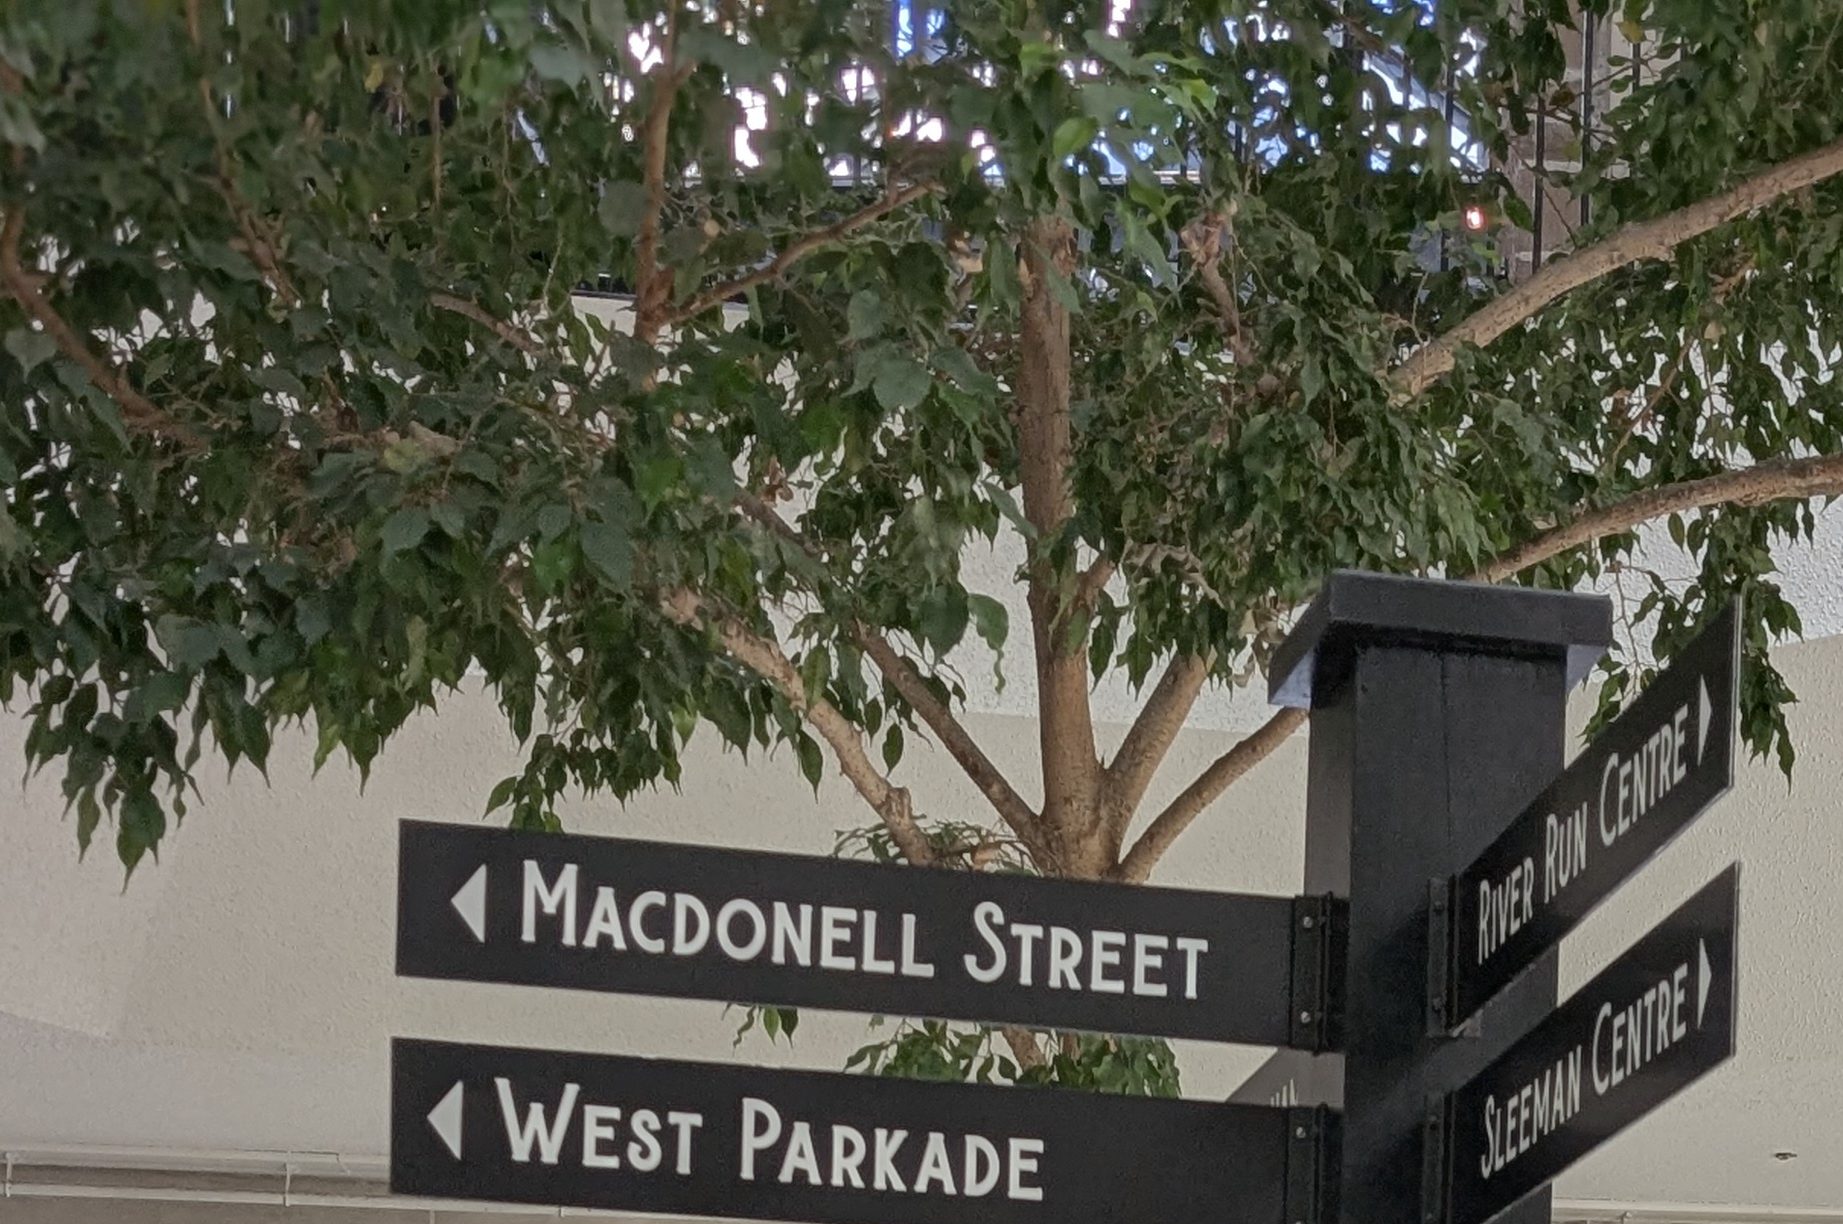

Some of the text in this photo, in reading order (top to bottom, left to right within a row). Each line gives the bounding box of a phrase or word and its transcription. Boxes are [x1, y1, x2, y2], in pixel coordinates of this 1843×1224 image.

[1478, 704, 1688, 964] RIVER RUN CENTRE
[521, 859, 1209, 1000] MACDONELL STREET
[494, 1077, 1044, 1201] WEST PARKADE
[1481, 963, 1688, 1178] SLEEMAN CENTRE
